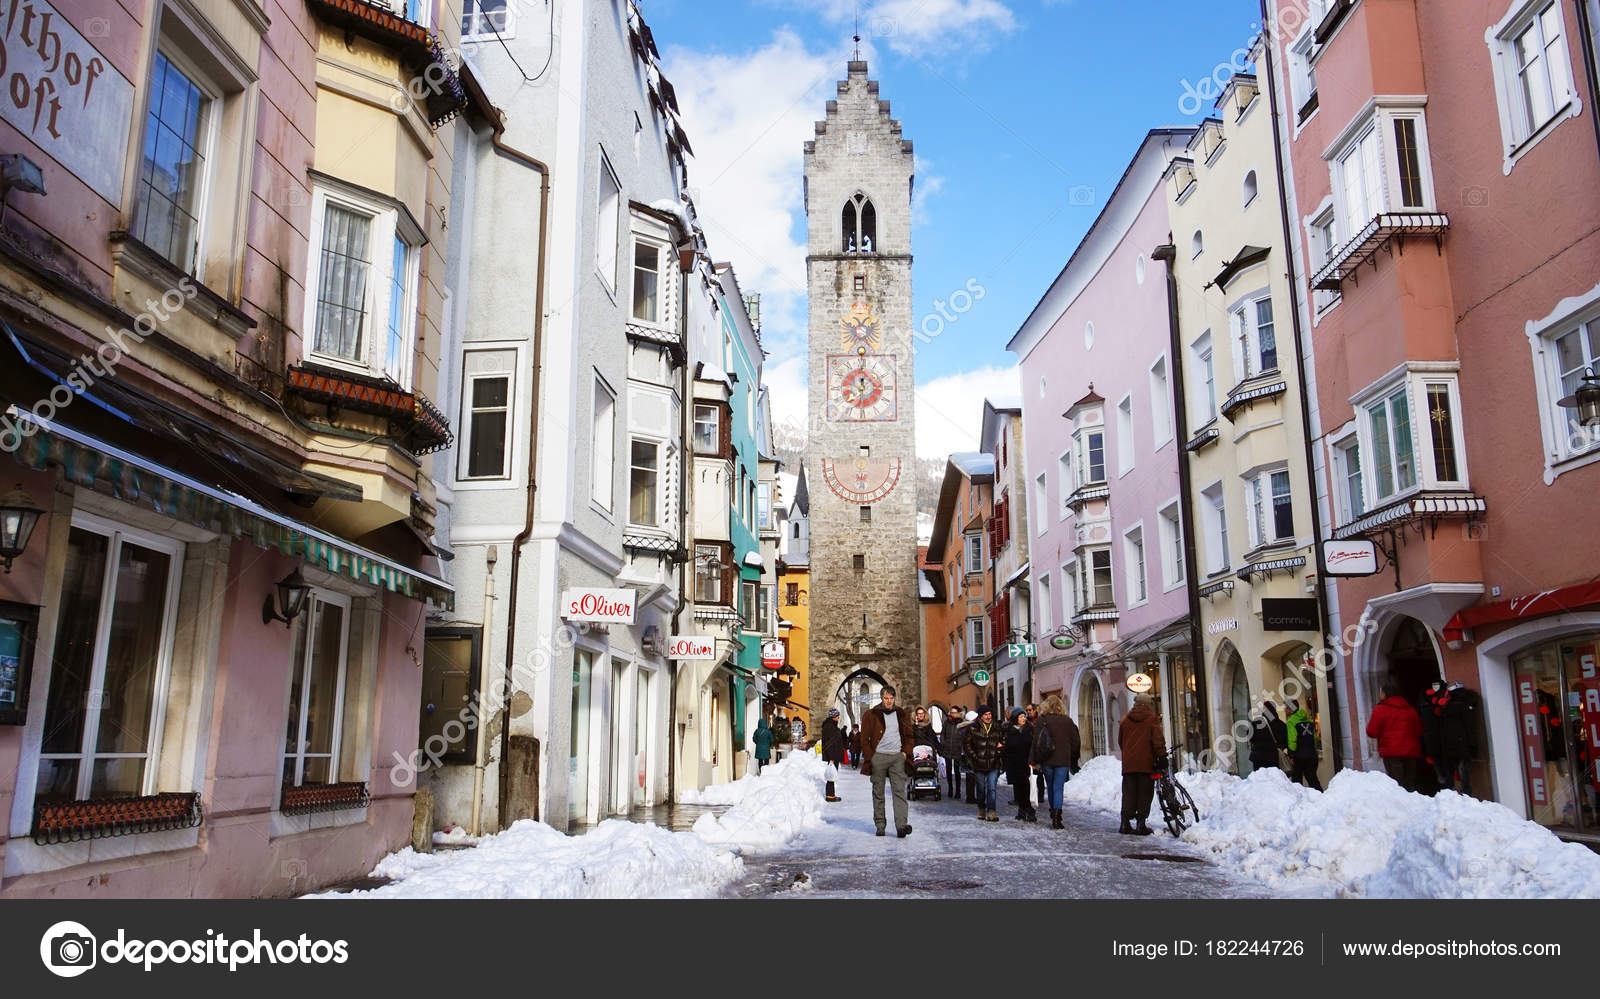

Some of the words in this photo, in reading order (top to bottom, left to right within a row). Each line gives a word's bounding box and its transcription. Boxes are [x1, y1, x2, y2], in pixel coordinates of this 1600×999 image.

[570, 593, 631, 617] s.Oliver
[670, 640, 712, 656] s.Oliver
[1520, 682, 1545, 801] SALE
